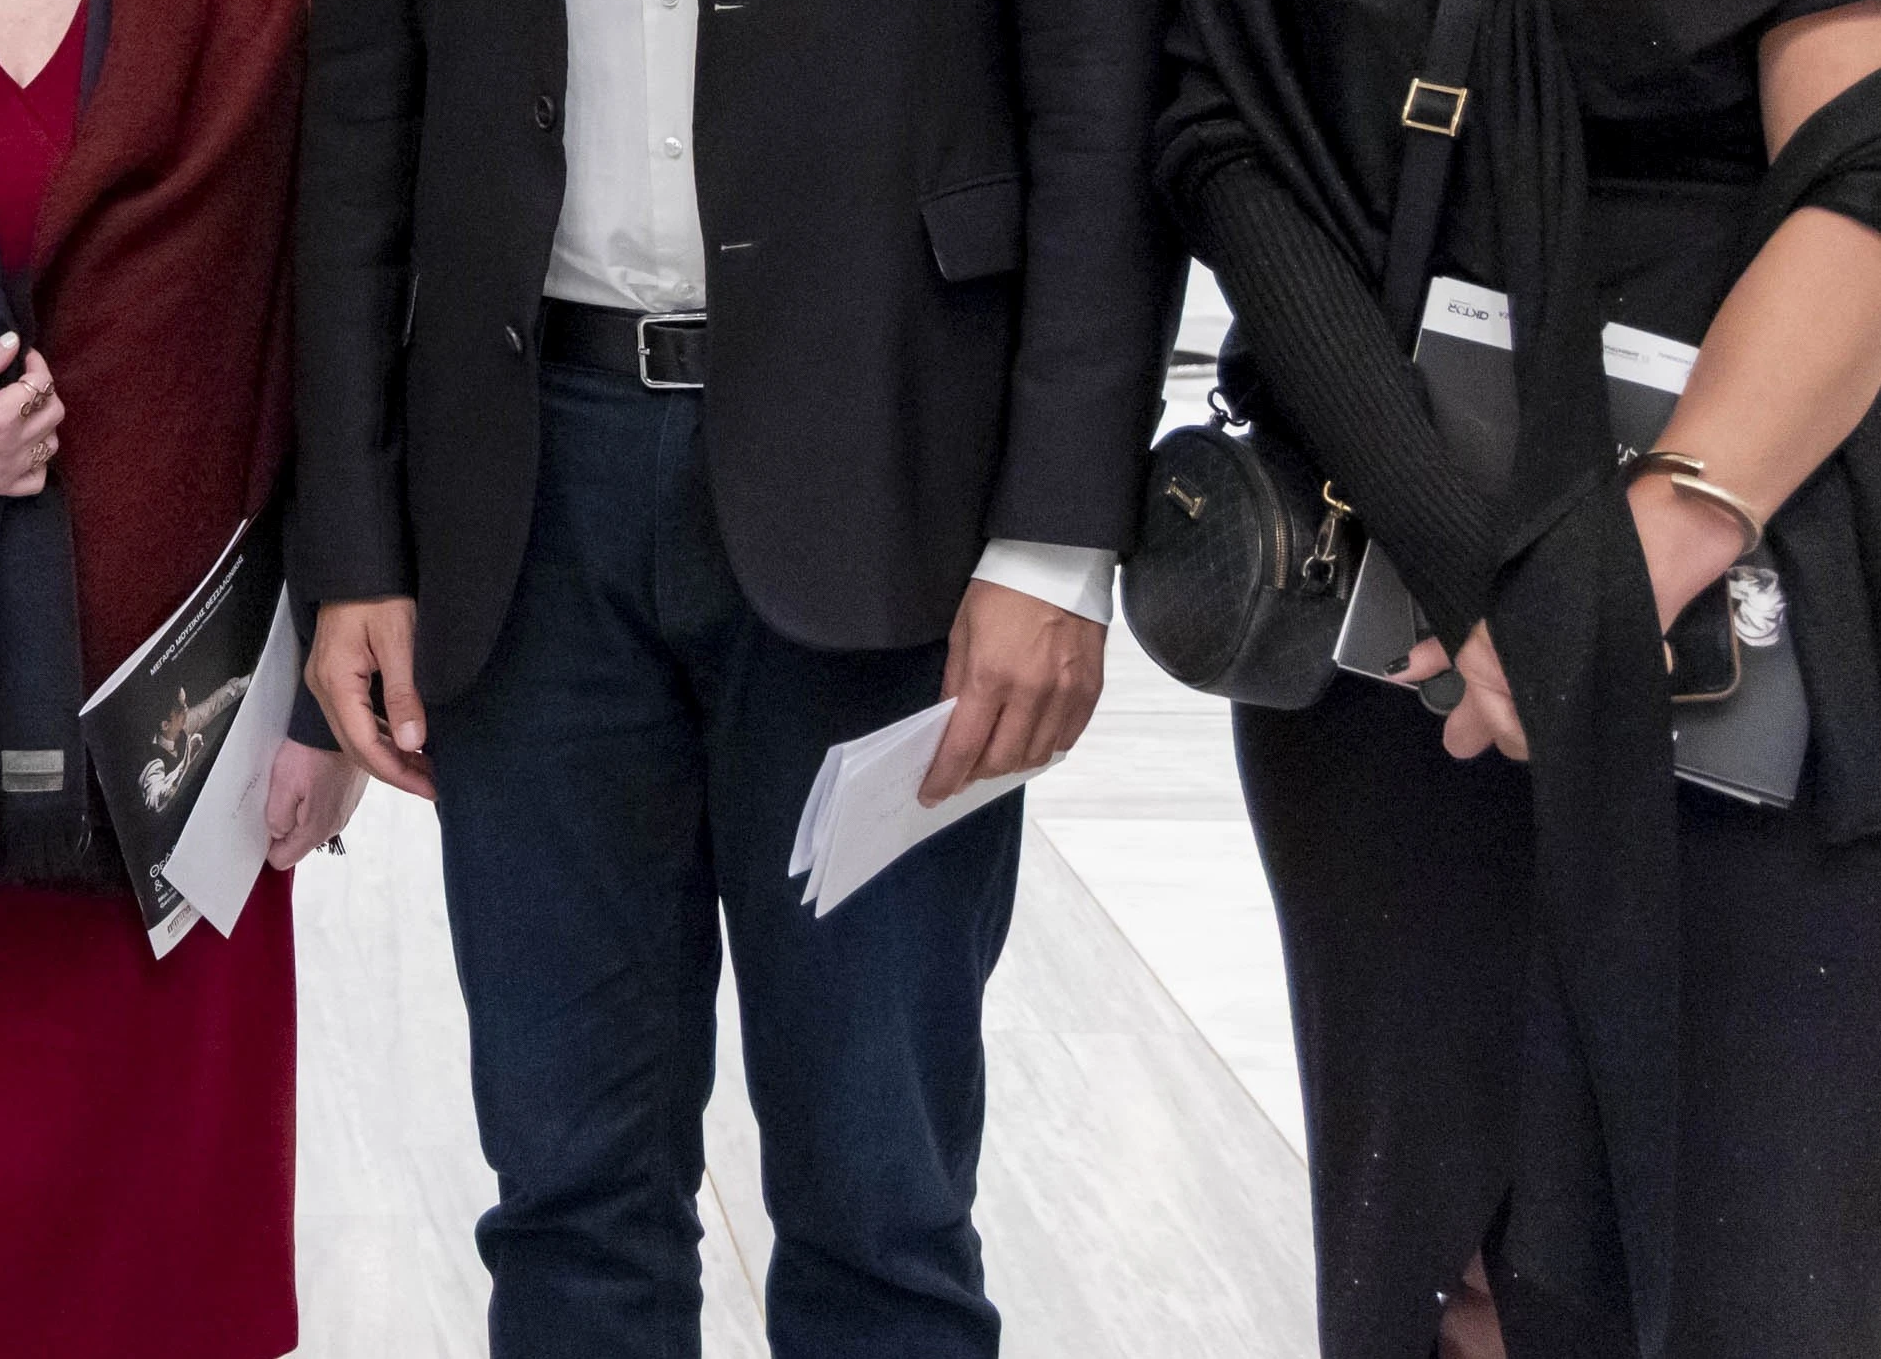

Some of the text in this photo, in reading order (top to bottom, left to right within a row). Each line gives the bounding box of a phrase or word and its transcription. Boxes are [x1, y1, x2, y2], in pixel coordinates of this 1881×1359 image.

[150, 644, 176, 676] ΜΕΓΑΡΟ
[175, 607, 207, 647] ΜΟΥΣΙΚΗΣ
[205, 553, 244, 610] ΘΕΣΣΑΛΟΝΙΚΗΣ
